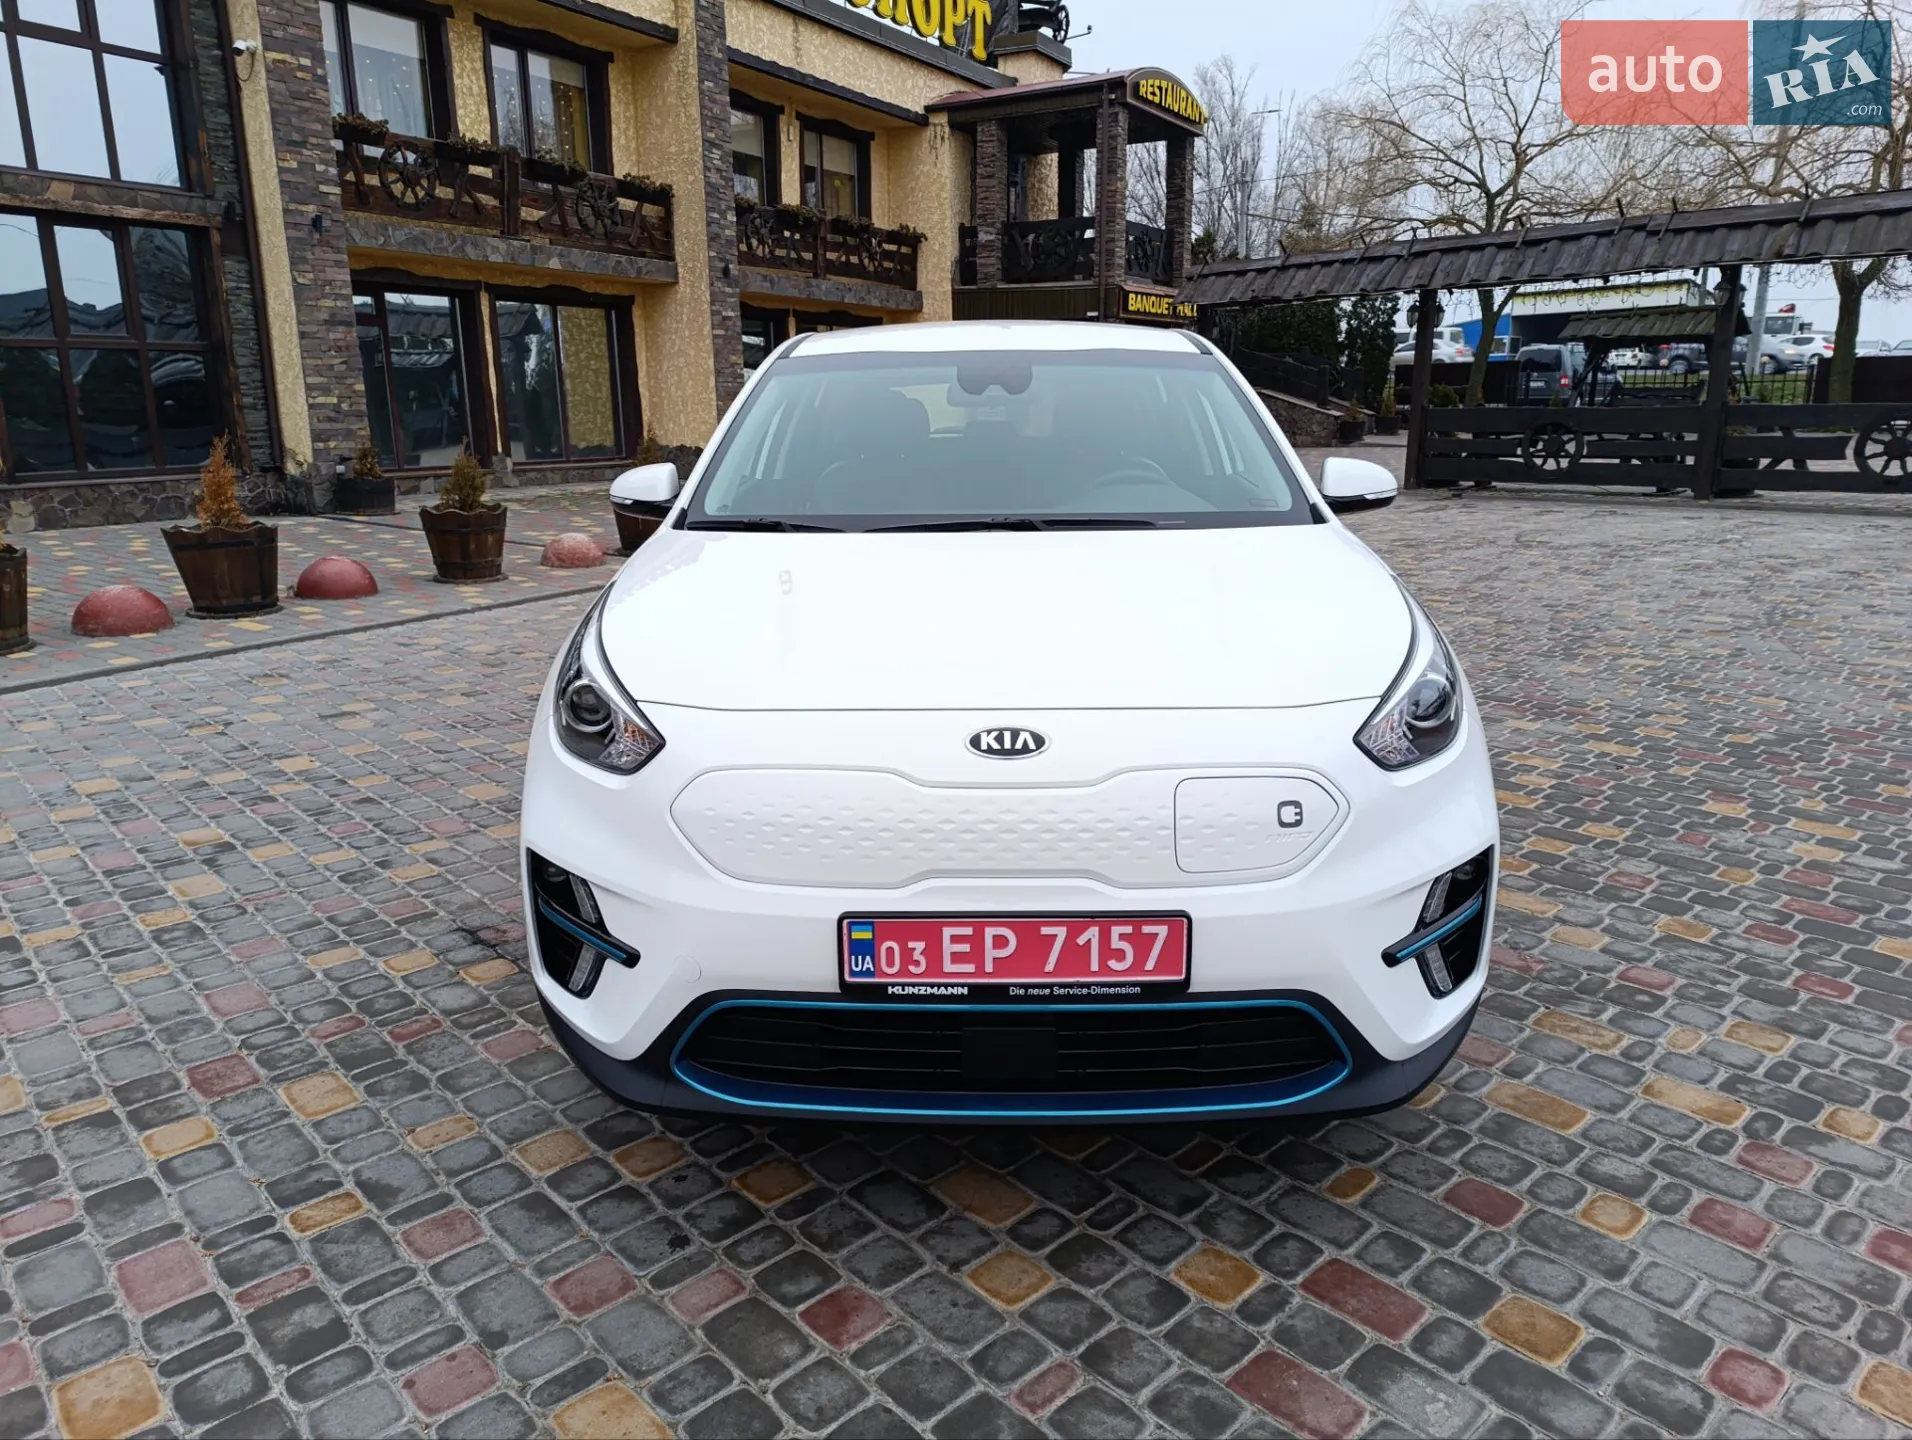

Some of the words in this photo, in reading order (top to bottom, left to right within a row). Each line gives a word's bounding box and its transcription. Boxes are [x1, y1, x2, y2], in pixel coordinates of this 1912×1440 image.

[1139, 79, 1208, 124] RESTAURANT
[979, 731, 1036, 750] KIA
[880, 941, 926, 975] 03
[1040, 925, 1169, 973] 7157
[851, 956, 874, 972] UA
[887, 985, 968, 995] KUNZMANN
[1009, 986, 1025, 996] Die
[1027, 988, 1050, 996] neue
[1053, 985, 1141, 995] Service-Dimension
